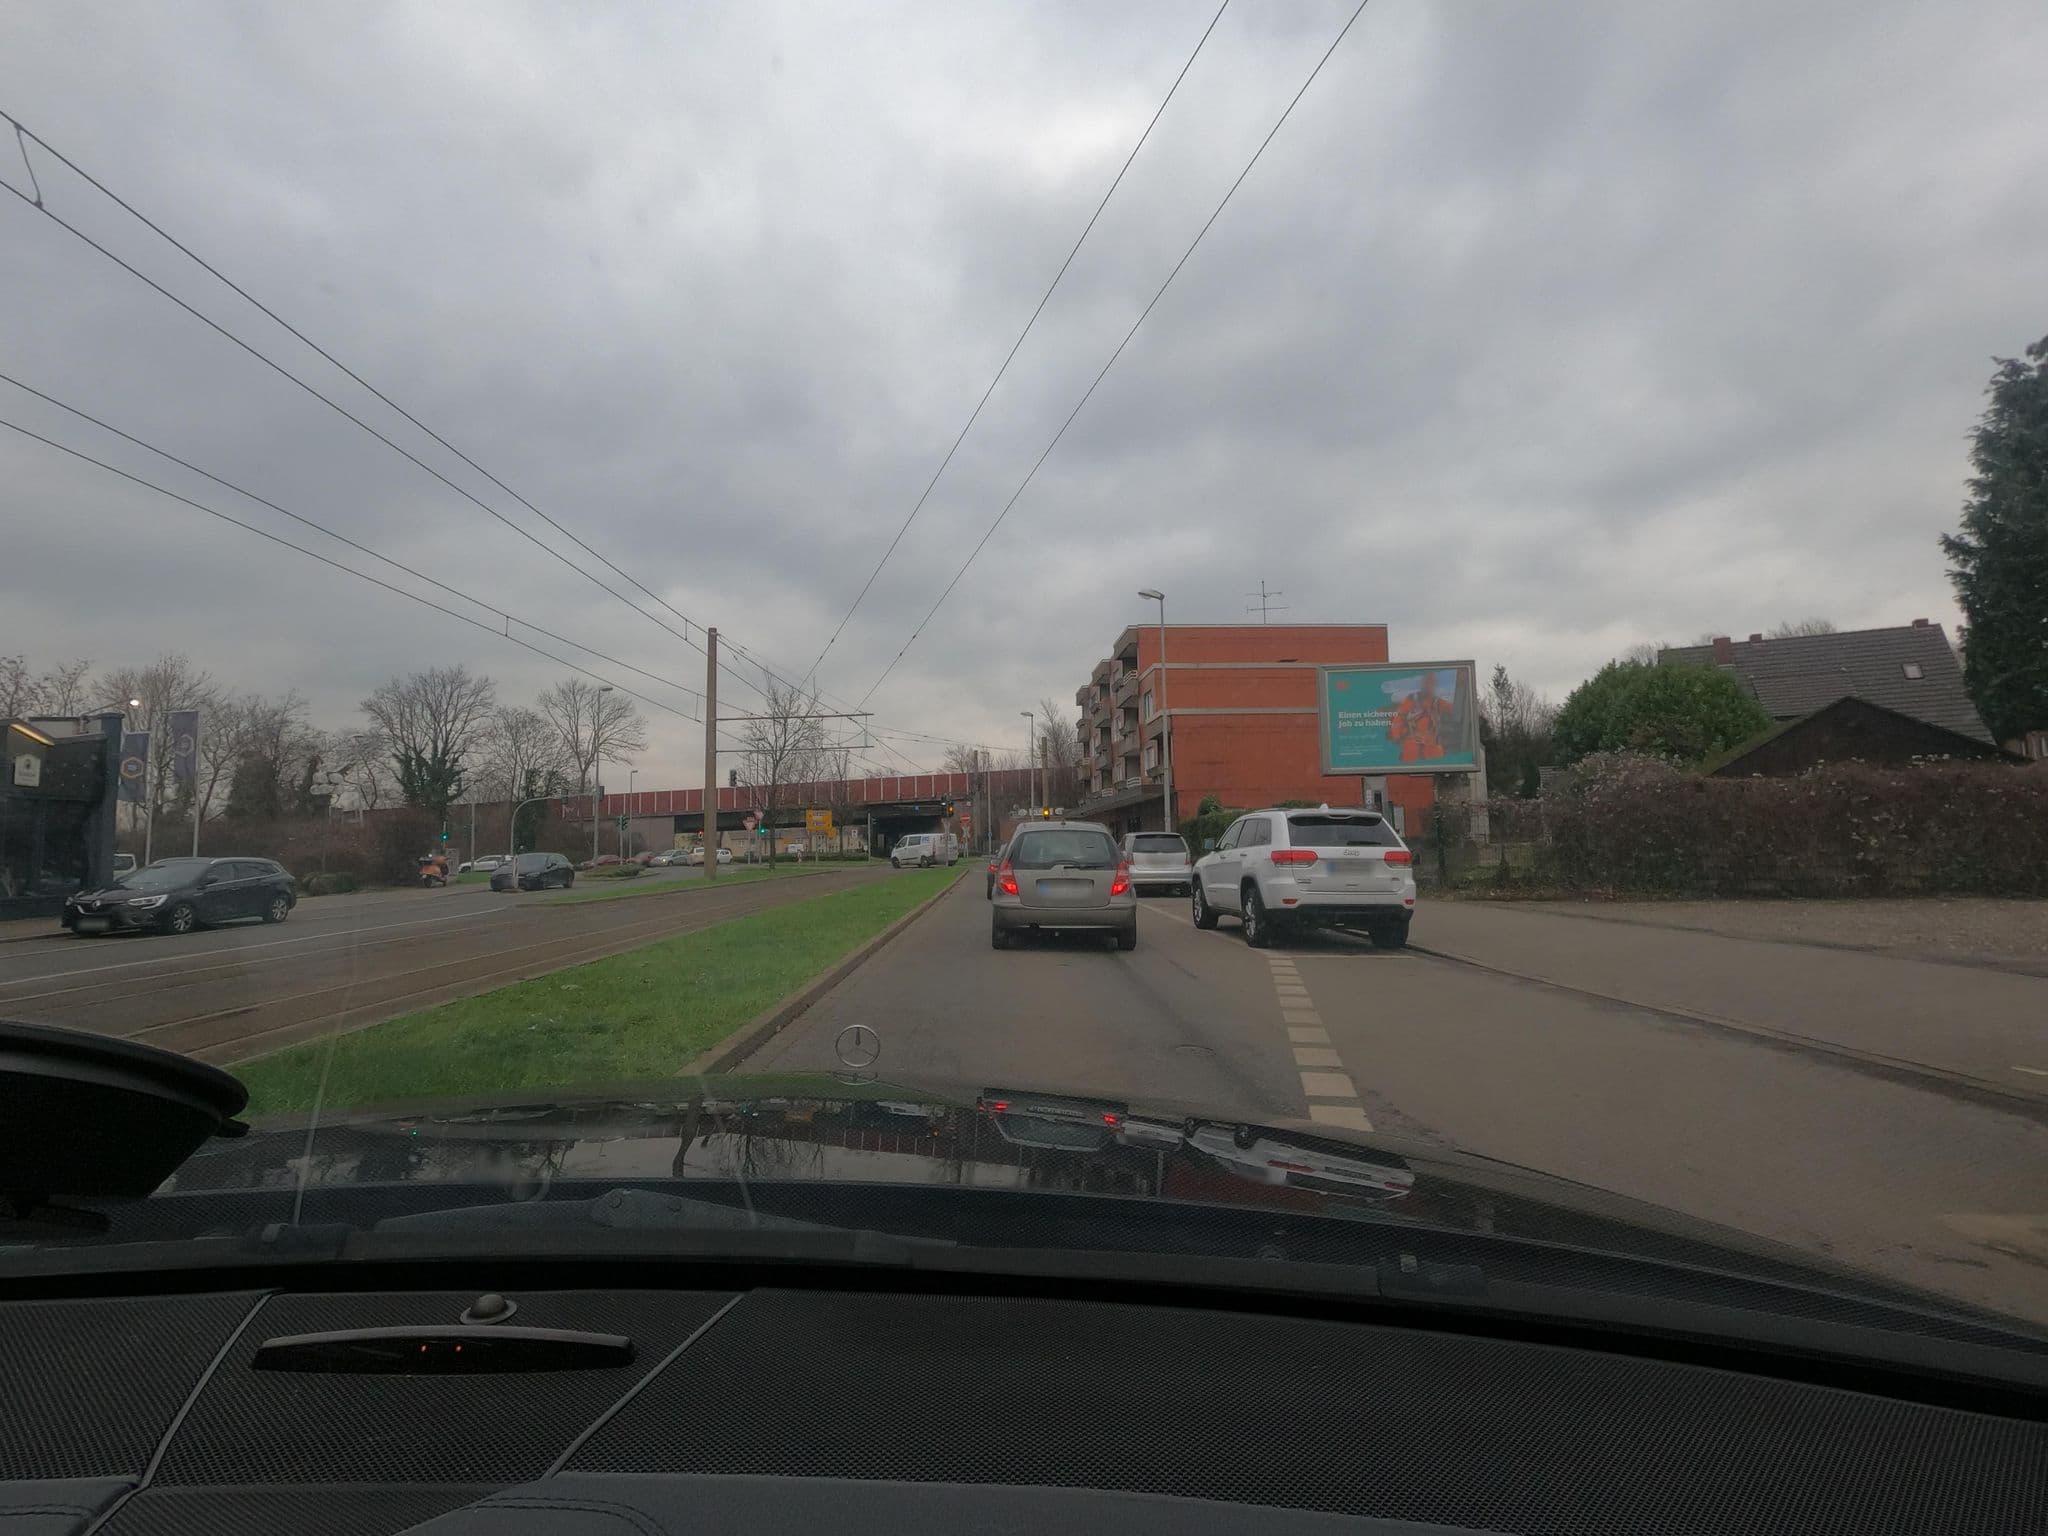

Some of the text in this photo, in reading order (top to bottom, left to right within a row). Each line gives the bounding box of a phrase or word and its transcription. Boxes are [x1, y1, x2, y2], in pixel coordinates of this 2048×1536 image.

[1338, 710, 1398, 719] Einen sicheren
[1338, 720, 1353, 729] Job
